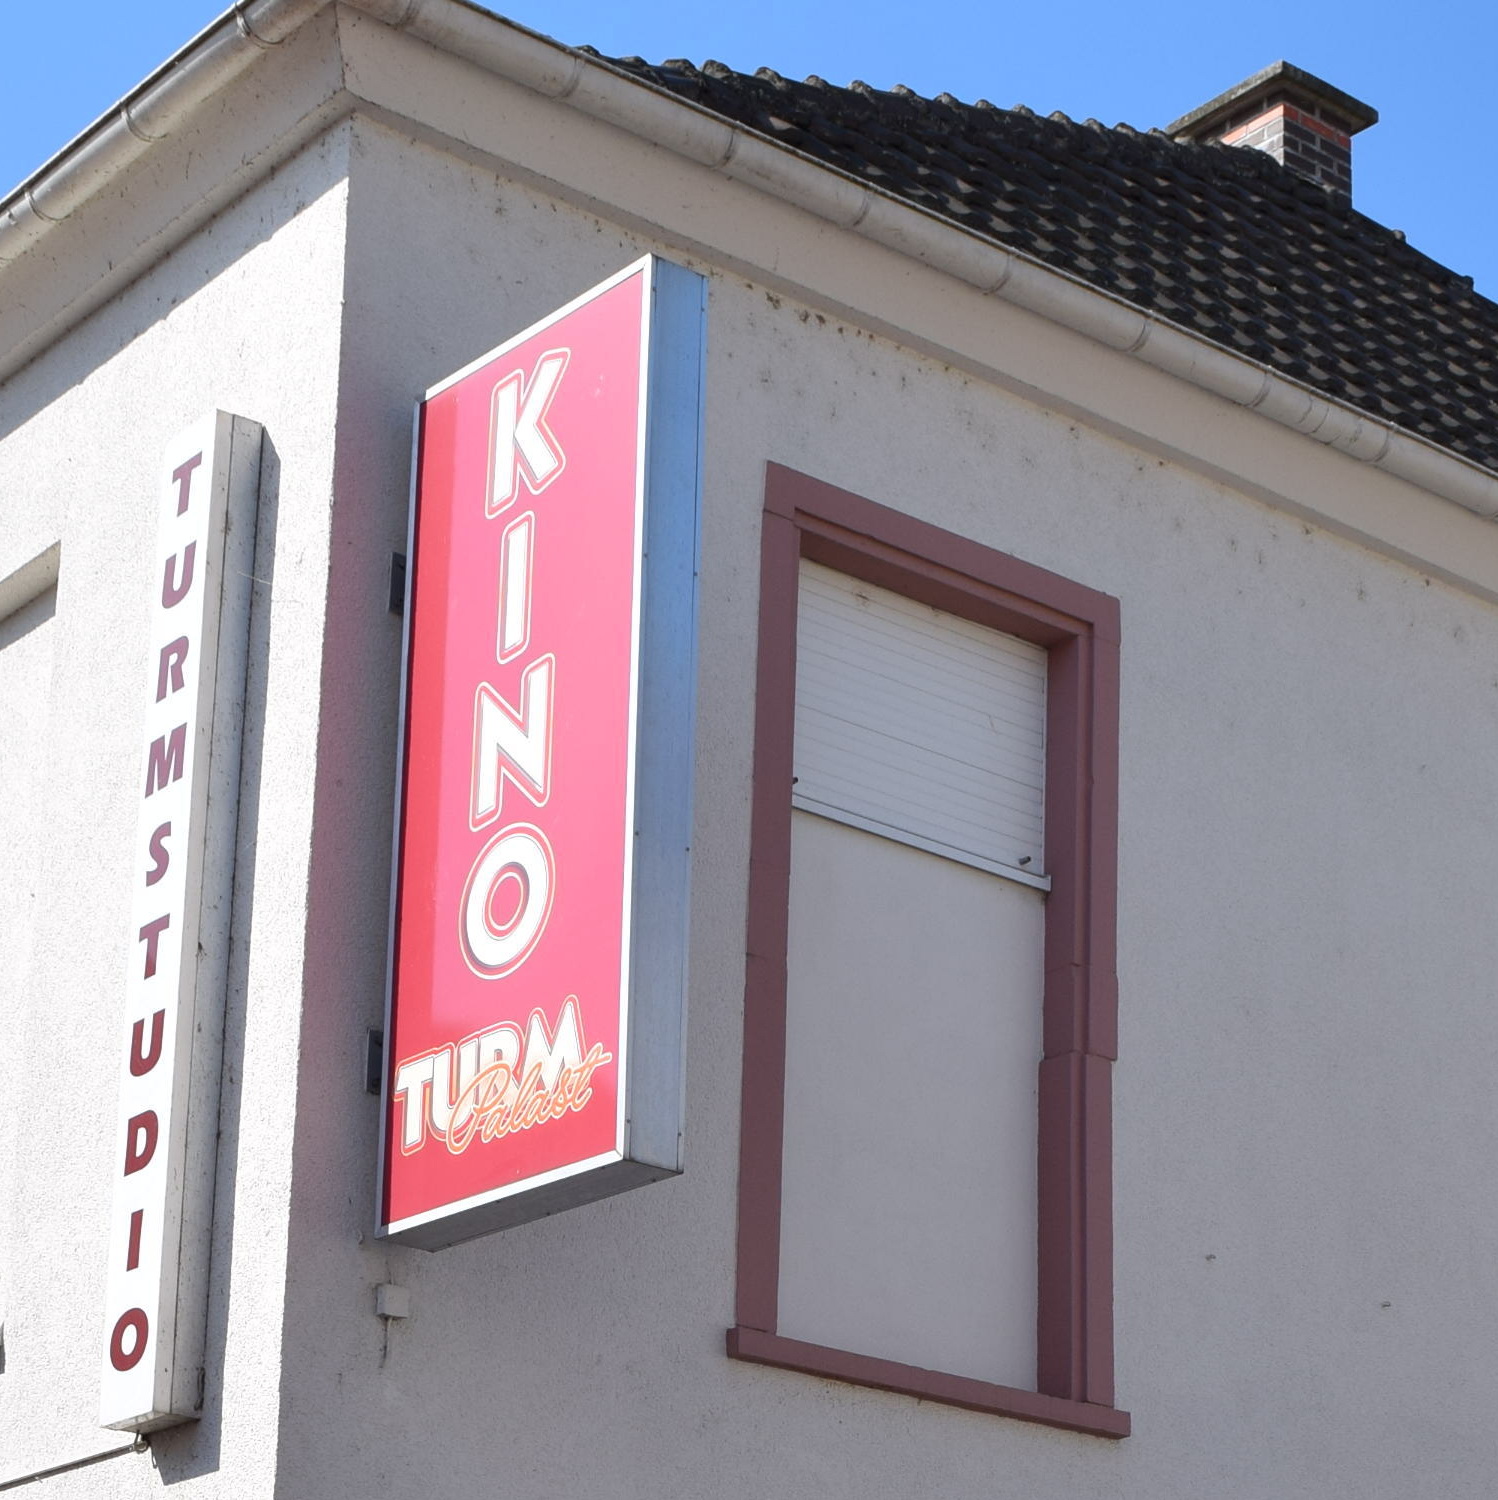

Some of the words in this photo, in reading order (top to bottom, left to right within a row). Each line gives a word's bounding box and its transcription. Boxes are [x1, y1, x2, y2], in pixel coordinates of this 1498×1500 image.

[458, 347, 571, 980] KINO
[109, 451, 202, 1372] TURMSTUDIO
[394, 997, 586, 1154] TURM
[447, 1042, 612, 1155] Palast
